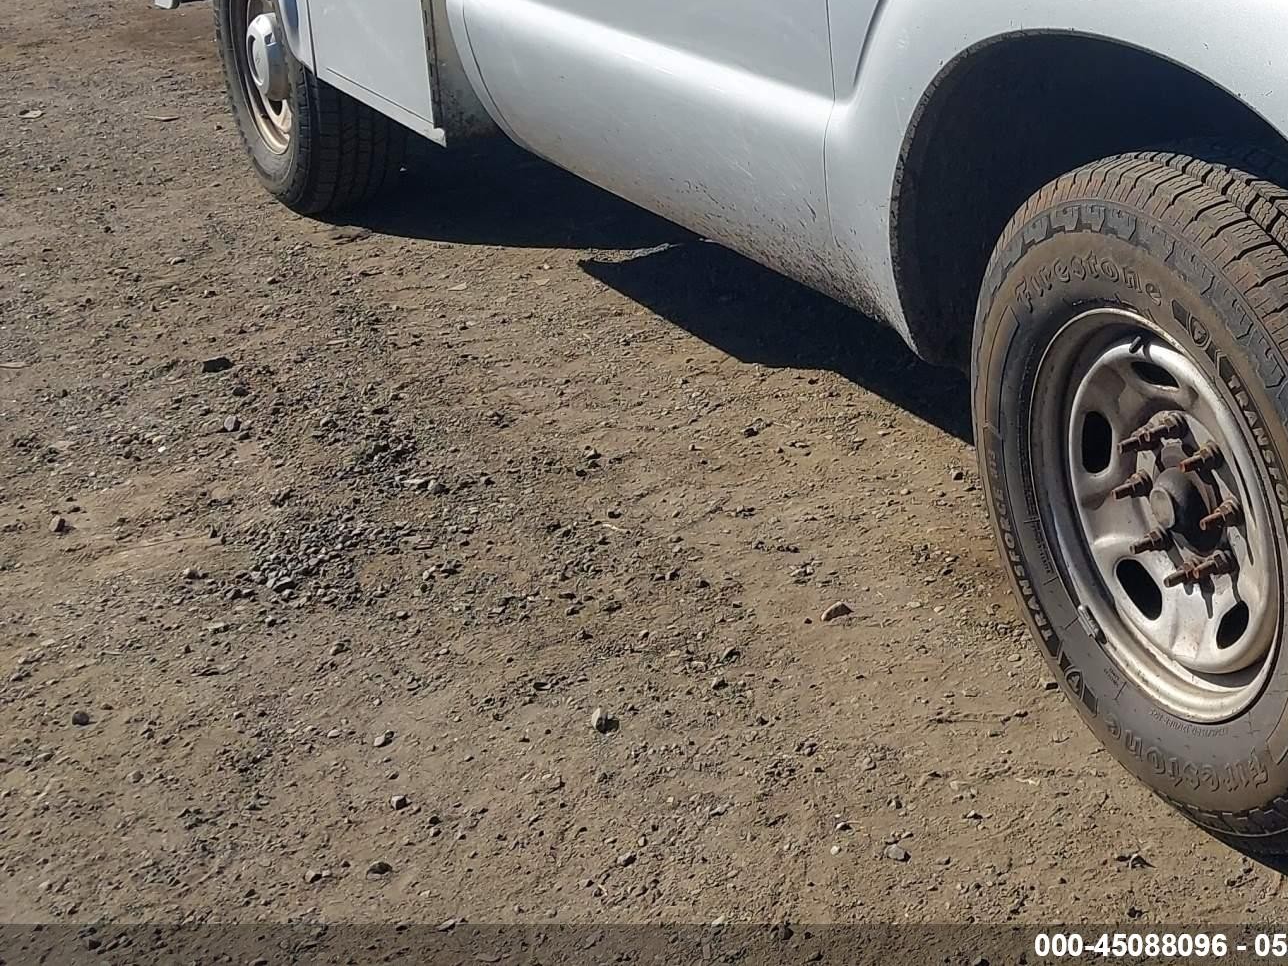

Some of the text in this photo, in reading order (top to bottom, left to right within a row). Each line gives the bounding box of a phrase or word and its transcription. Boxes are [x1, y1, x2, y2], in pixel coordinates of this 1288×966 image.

[1014, 250, 1162, 313] Firestone
[993, 487, 1052, 642] TRANSFORCE
[1104, 714, 1269, 792] Firestone
